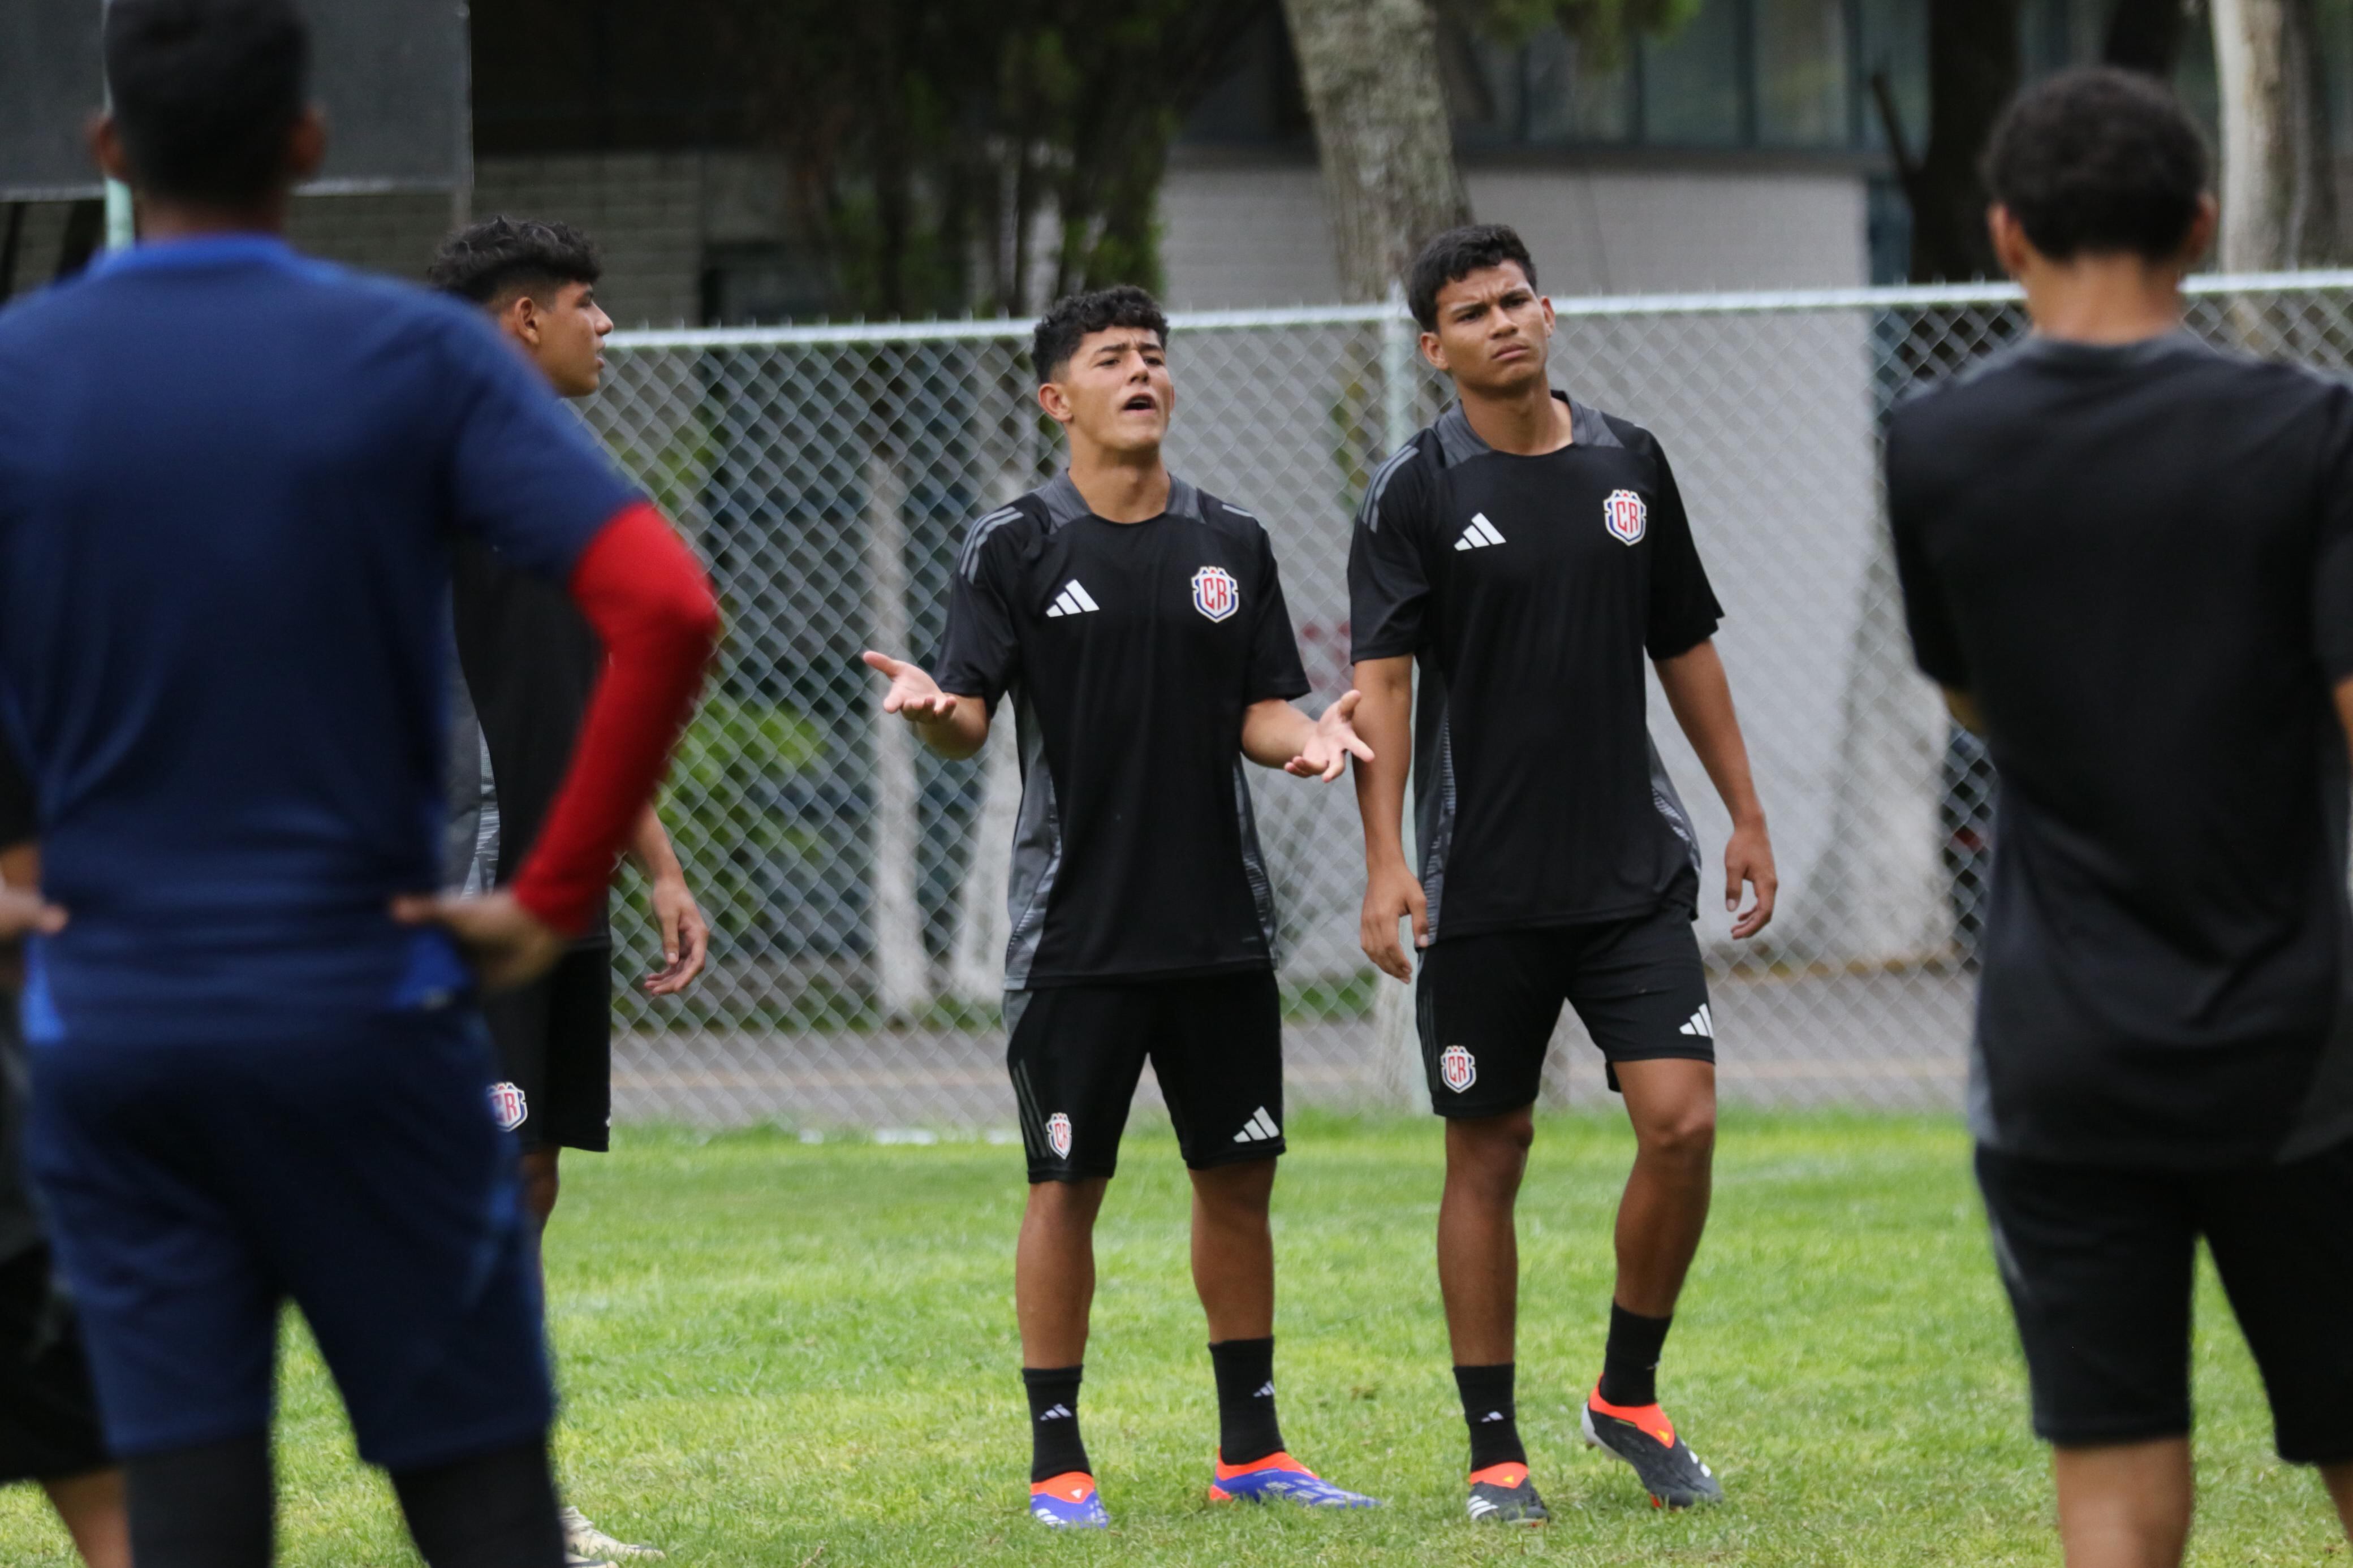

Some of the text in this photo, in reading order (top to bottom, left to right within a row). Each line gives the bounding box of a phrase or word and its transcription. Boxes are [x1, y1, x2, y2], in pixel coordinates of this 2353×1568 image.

[1615, 500, 1639, 534] CR
[1203, 576, 1227, 610] CR
[1447, 1056, 1467, 1082] CR
[1054, 1122, 1069, 1148] CR
